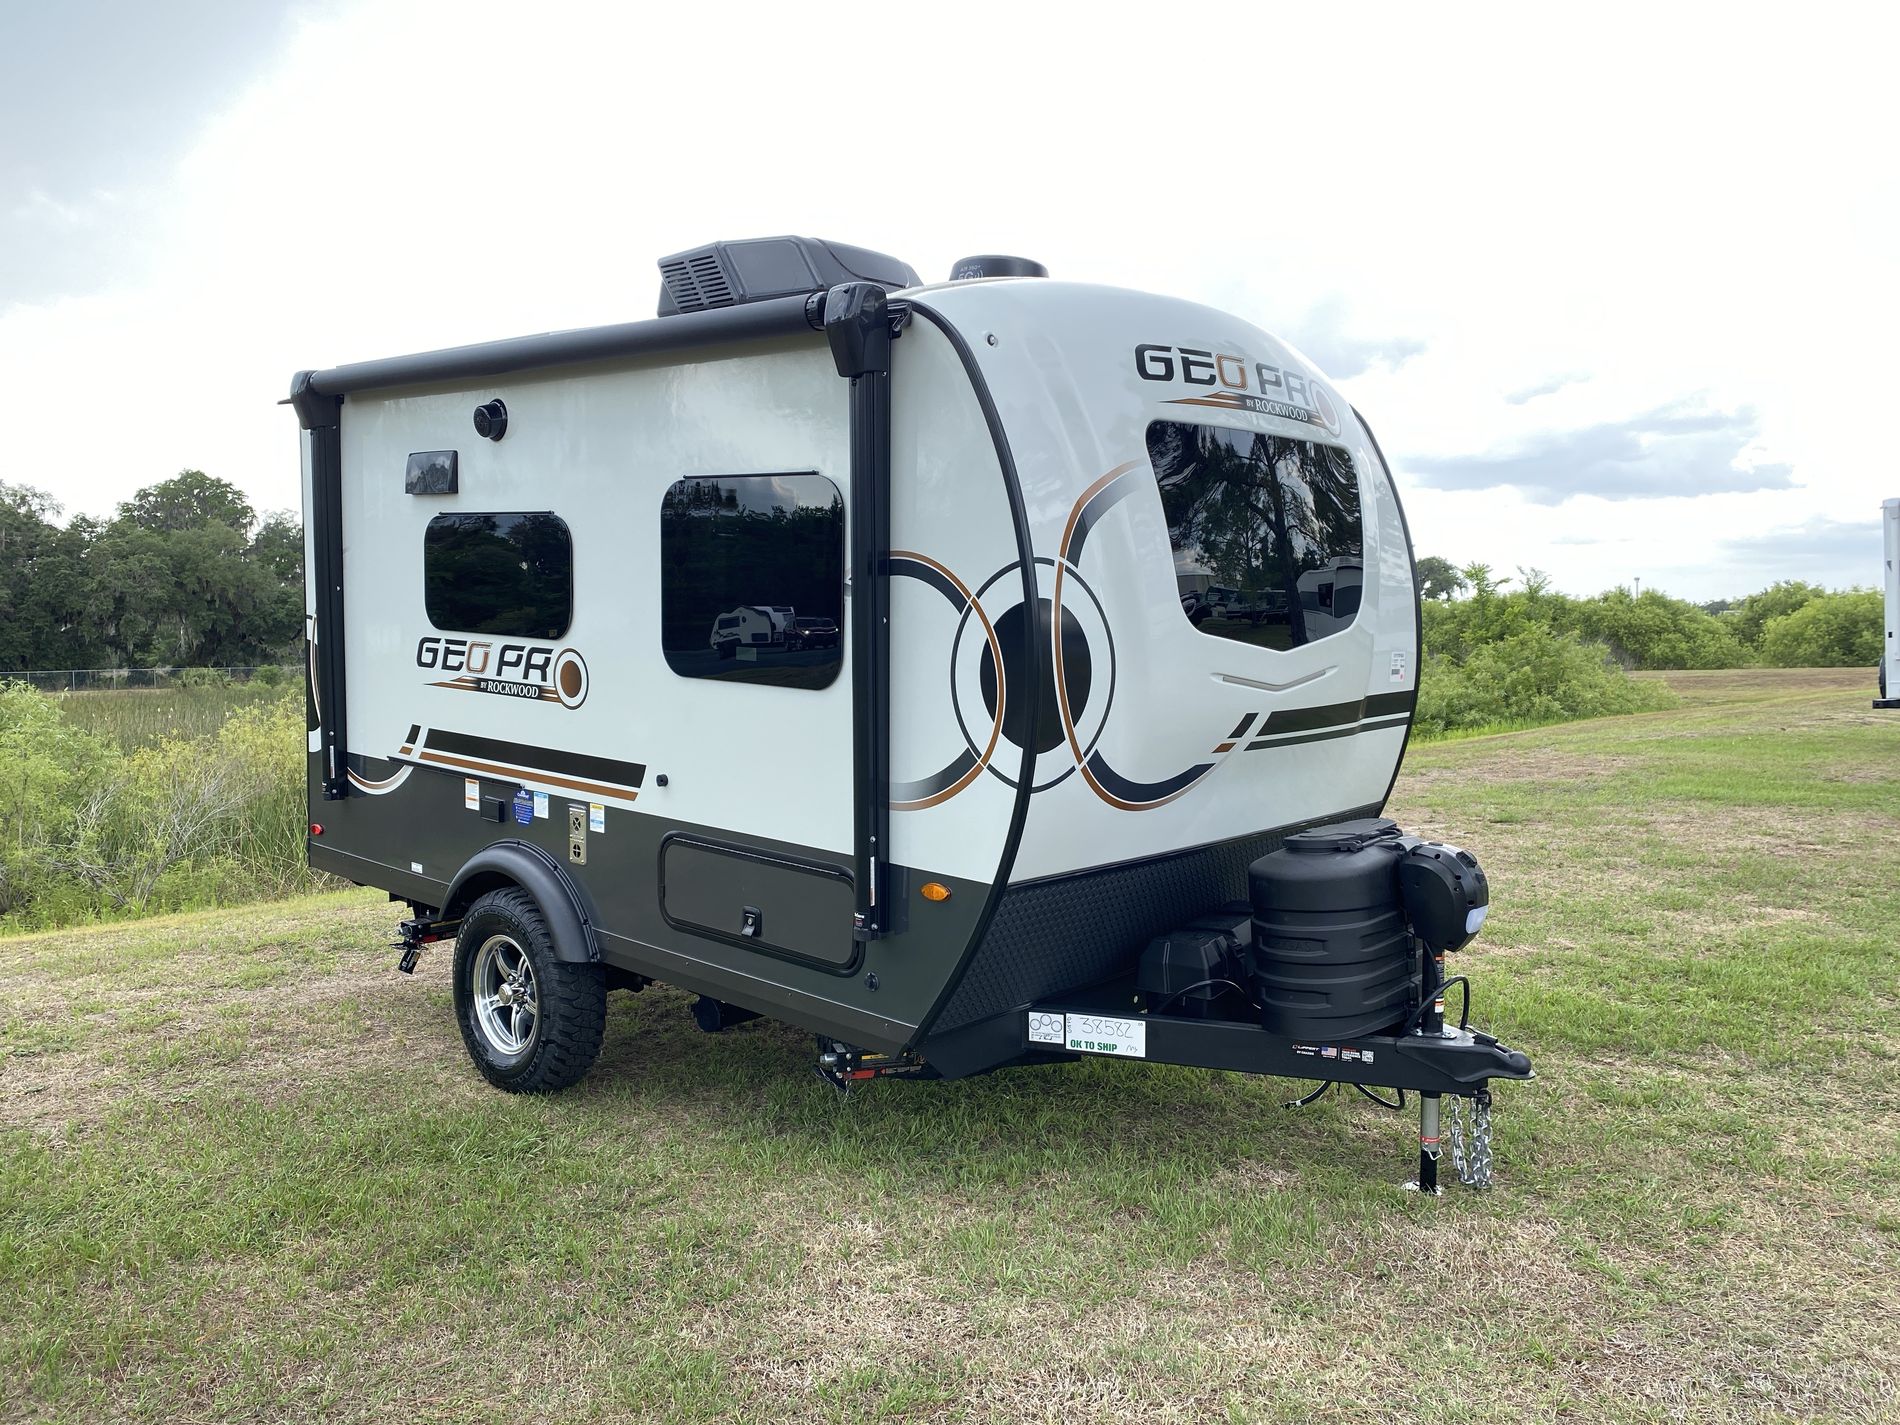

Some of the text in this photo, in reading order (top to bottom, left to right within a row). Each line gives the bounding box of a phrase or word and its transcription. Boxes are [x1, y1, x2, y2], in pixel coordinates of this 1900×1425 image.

[1134, 343, 1342, 438] GEO PRO
[1246, 399, 1308, 422] BY ROCKWOOD
[416, 636, 589, 710] GEO PRO
[480, 680, 539, 698] BY ROCKWOOD
[1079, 1017, 1134, 1039] 38582
[1070, 1039, 1082, 1049] OK
[1084, 1040, 1095, 1050] TO
[1097, 1042, 1118, 1052] SHIP
